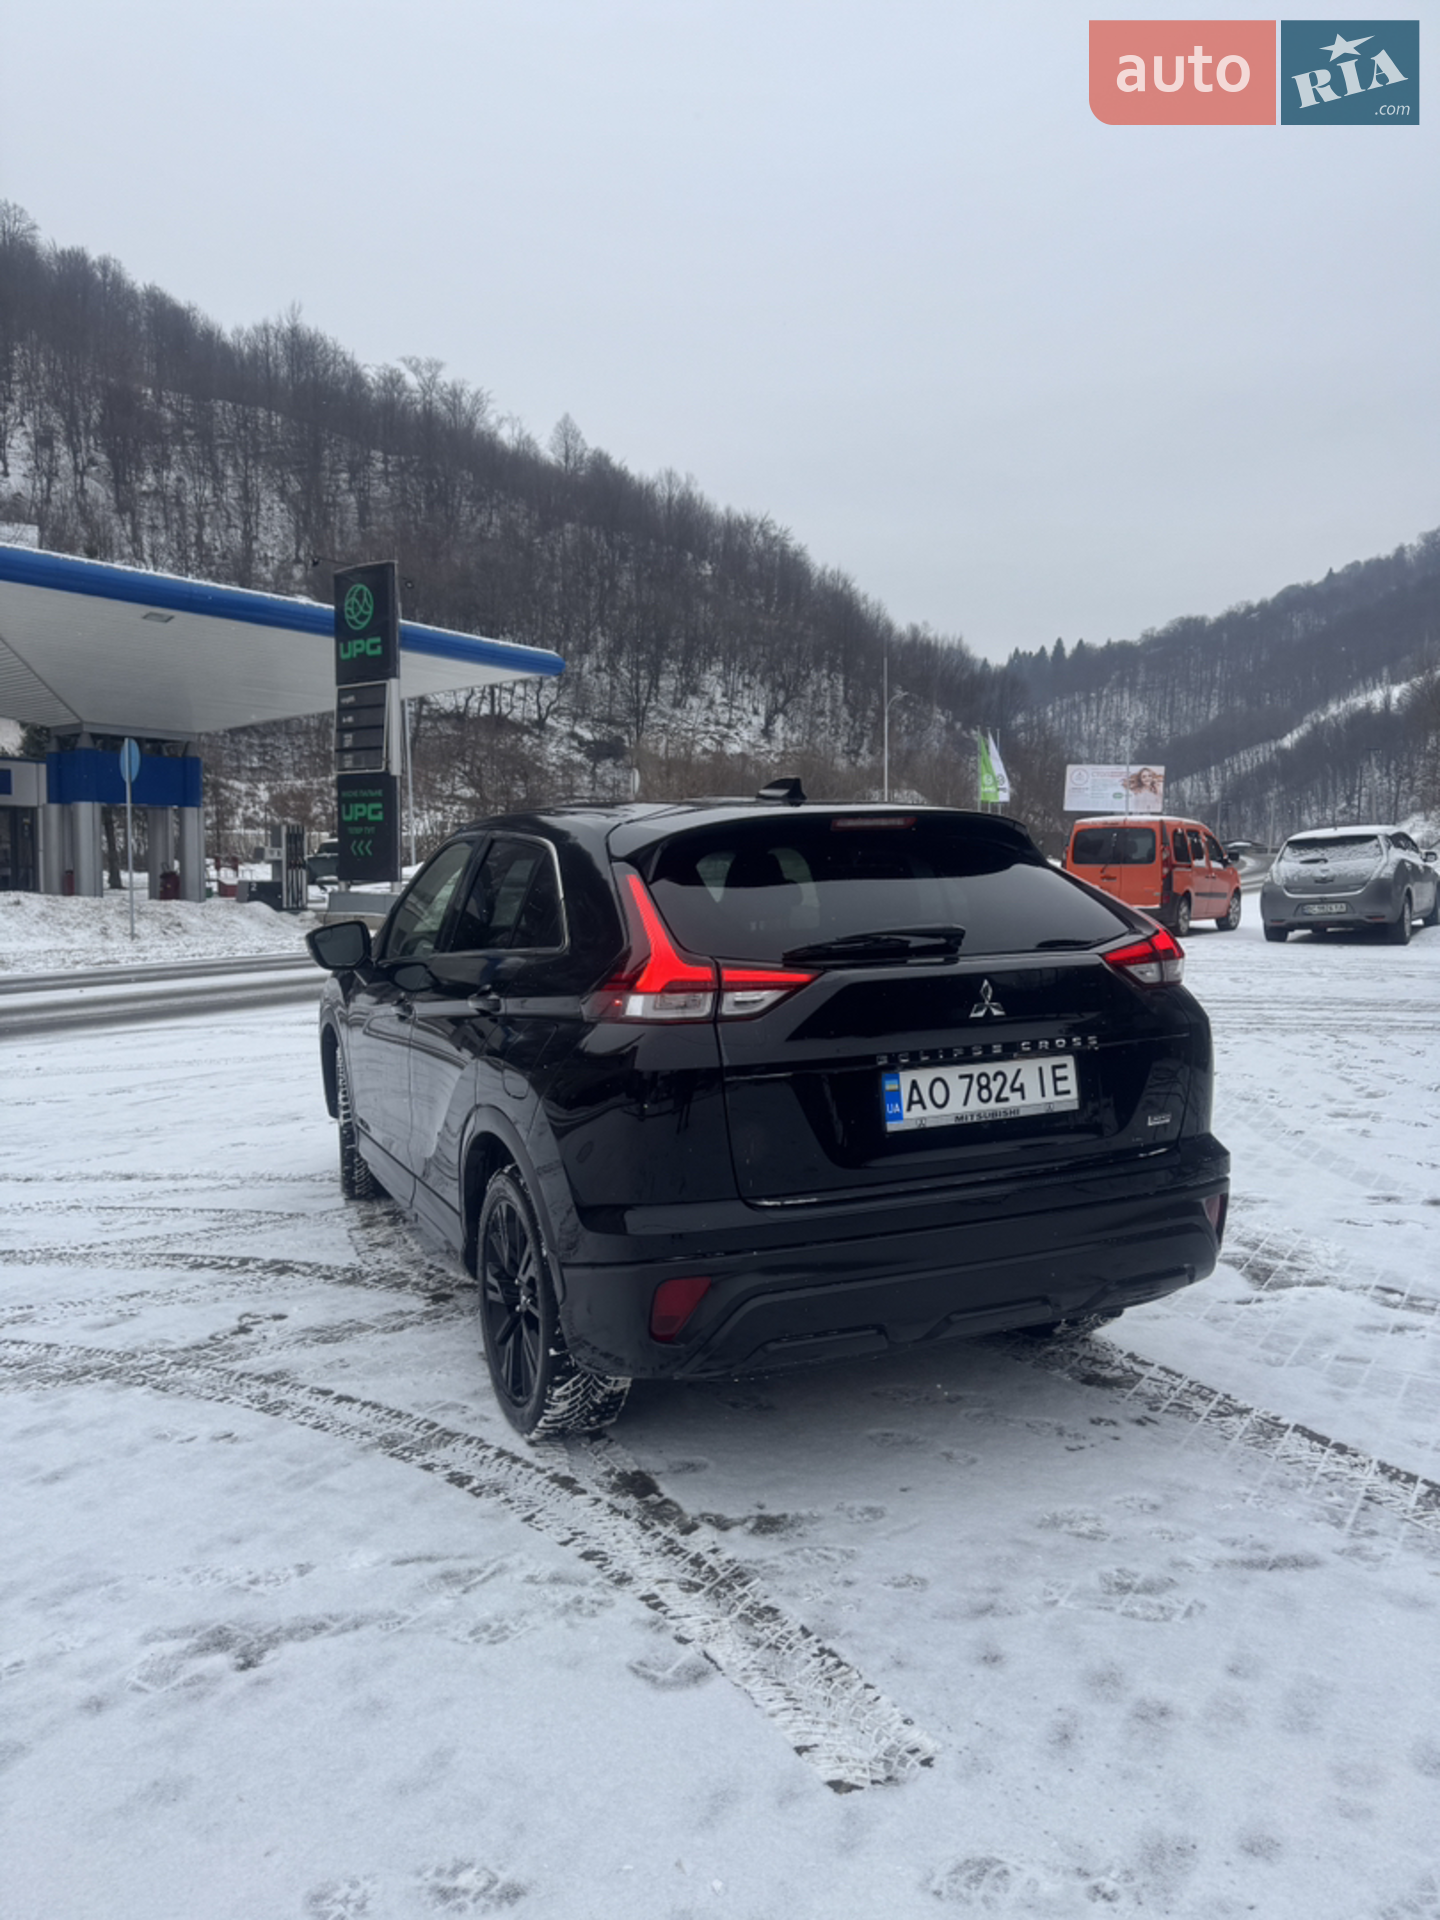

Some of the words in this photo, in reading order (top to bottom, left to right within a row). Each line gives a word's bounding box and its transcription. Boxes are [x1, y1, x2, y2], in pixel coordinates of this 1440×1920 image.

[340, 636, 382, 659] UPG
[341, 802, 384, 822] UPG
[1020, 1035, 1099, 1053] CROSS
[906, 1076, 950, 1112] AO
[958, 1068, 1026, 1107] 7824
[1038, 1064, 1071, 1098] IE
[886, 1102, 901, 1114] UA
[954, 1108, 1020, 1123] MITSUBISHI
